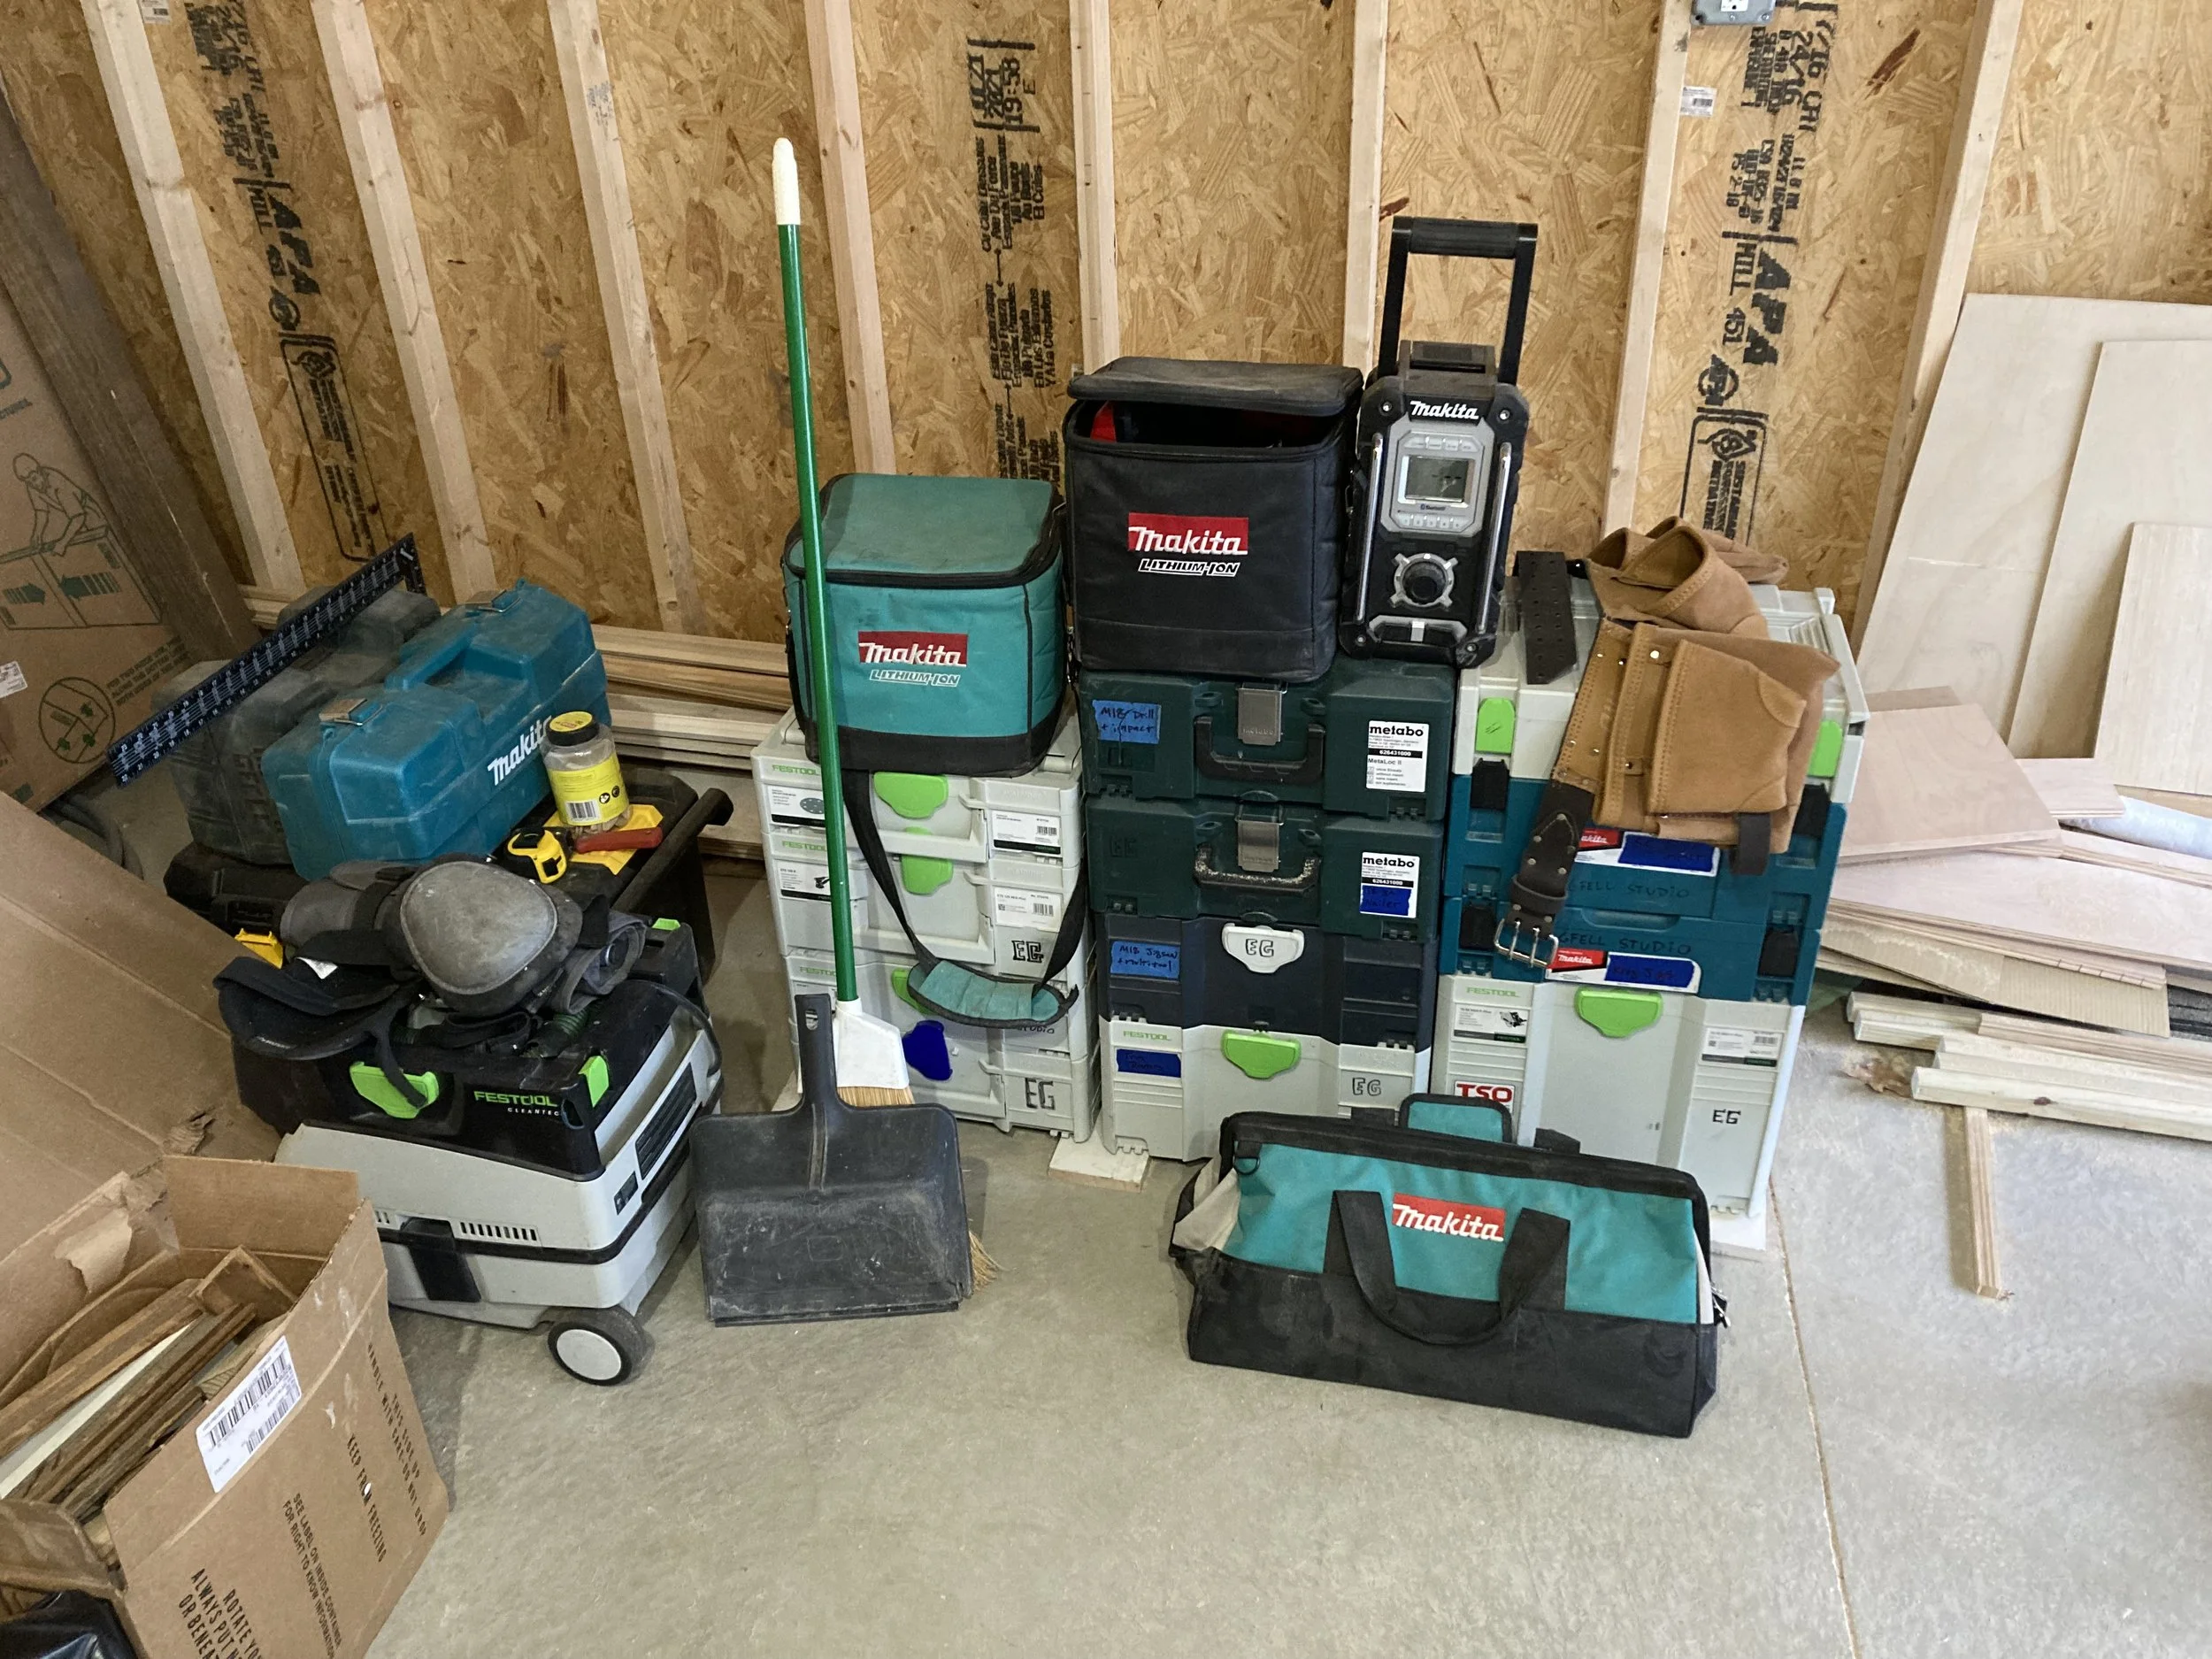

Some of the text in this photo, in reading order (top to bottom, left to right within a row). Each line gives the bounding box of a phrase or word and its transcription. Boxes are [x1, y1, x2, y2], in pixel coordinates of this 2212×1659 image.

[1021, 79, 1035, 94] E
[267, 193, 320, 295] APA
[1722, 242, 1755, 348] MILL 451
[1743, 249, 1793, 368] APA
[1409, 401, 1479, 419] Makita
[1129, 526, 1248, 555] Makita
[1138, 558, 1240, 578] LITHIUM-ION
[858, 641, 967, 668] Makita
[870, 668, 961, 687] LITHIUM-ION
[1133, 709, 1154, 719] Drill
[1369, 726, 1424, 737] metabo
[772, 764, 821, 776] FESTOOL
[1580, 834, 1608, 845] akita
[1363, 857, 1415, 868] metabo
[1010, 940, 1045, 964] EG
[1245, 937, 1276, 959] EG
[1466, 987, 1521, 998] FESTOOL
[1123, 1030, 1172, 1041] FESTOOL
[1025, 1077, 1056, 1110] EG
[1352, 1077, 1382, 1096] EG
[1456, 1083, 1513, 1103] TSO
[473, 1090, 558, 1108] FESTOOL
[507, 1107, 560, 1117] CLEANTEC
[1712, 1109, 1741, 1125] EG
[1392, 1202, 1504, 1243] Makita
[411, 1461, 420, 1479] UP
[347, 1433, 362, 1468] KEEP
[368, 1504, 387, 1563] FREEZING
[408, 1481, 418, 1506] NOT
[414, 1507, 426, 1536] DROP
[282, 1500, 295, 1525] FOR
[289, 1523, 305, 1555] RIGHT
[293, 1493, 342, 1649] SEE LABEL ON INSIDE CONTAINER
[301, 1554, 311, 1571] TO
[305, 1569, 319, 1601] KNOW
[179, 1594, 196, 1618] OR
[191, 1568, 234, 1652] ALWAYS PUT
[223, 1588, 253, 1644] ROTATE
